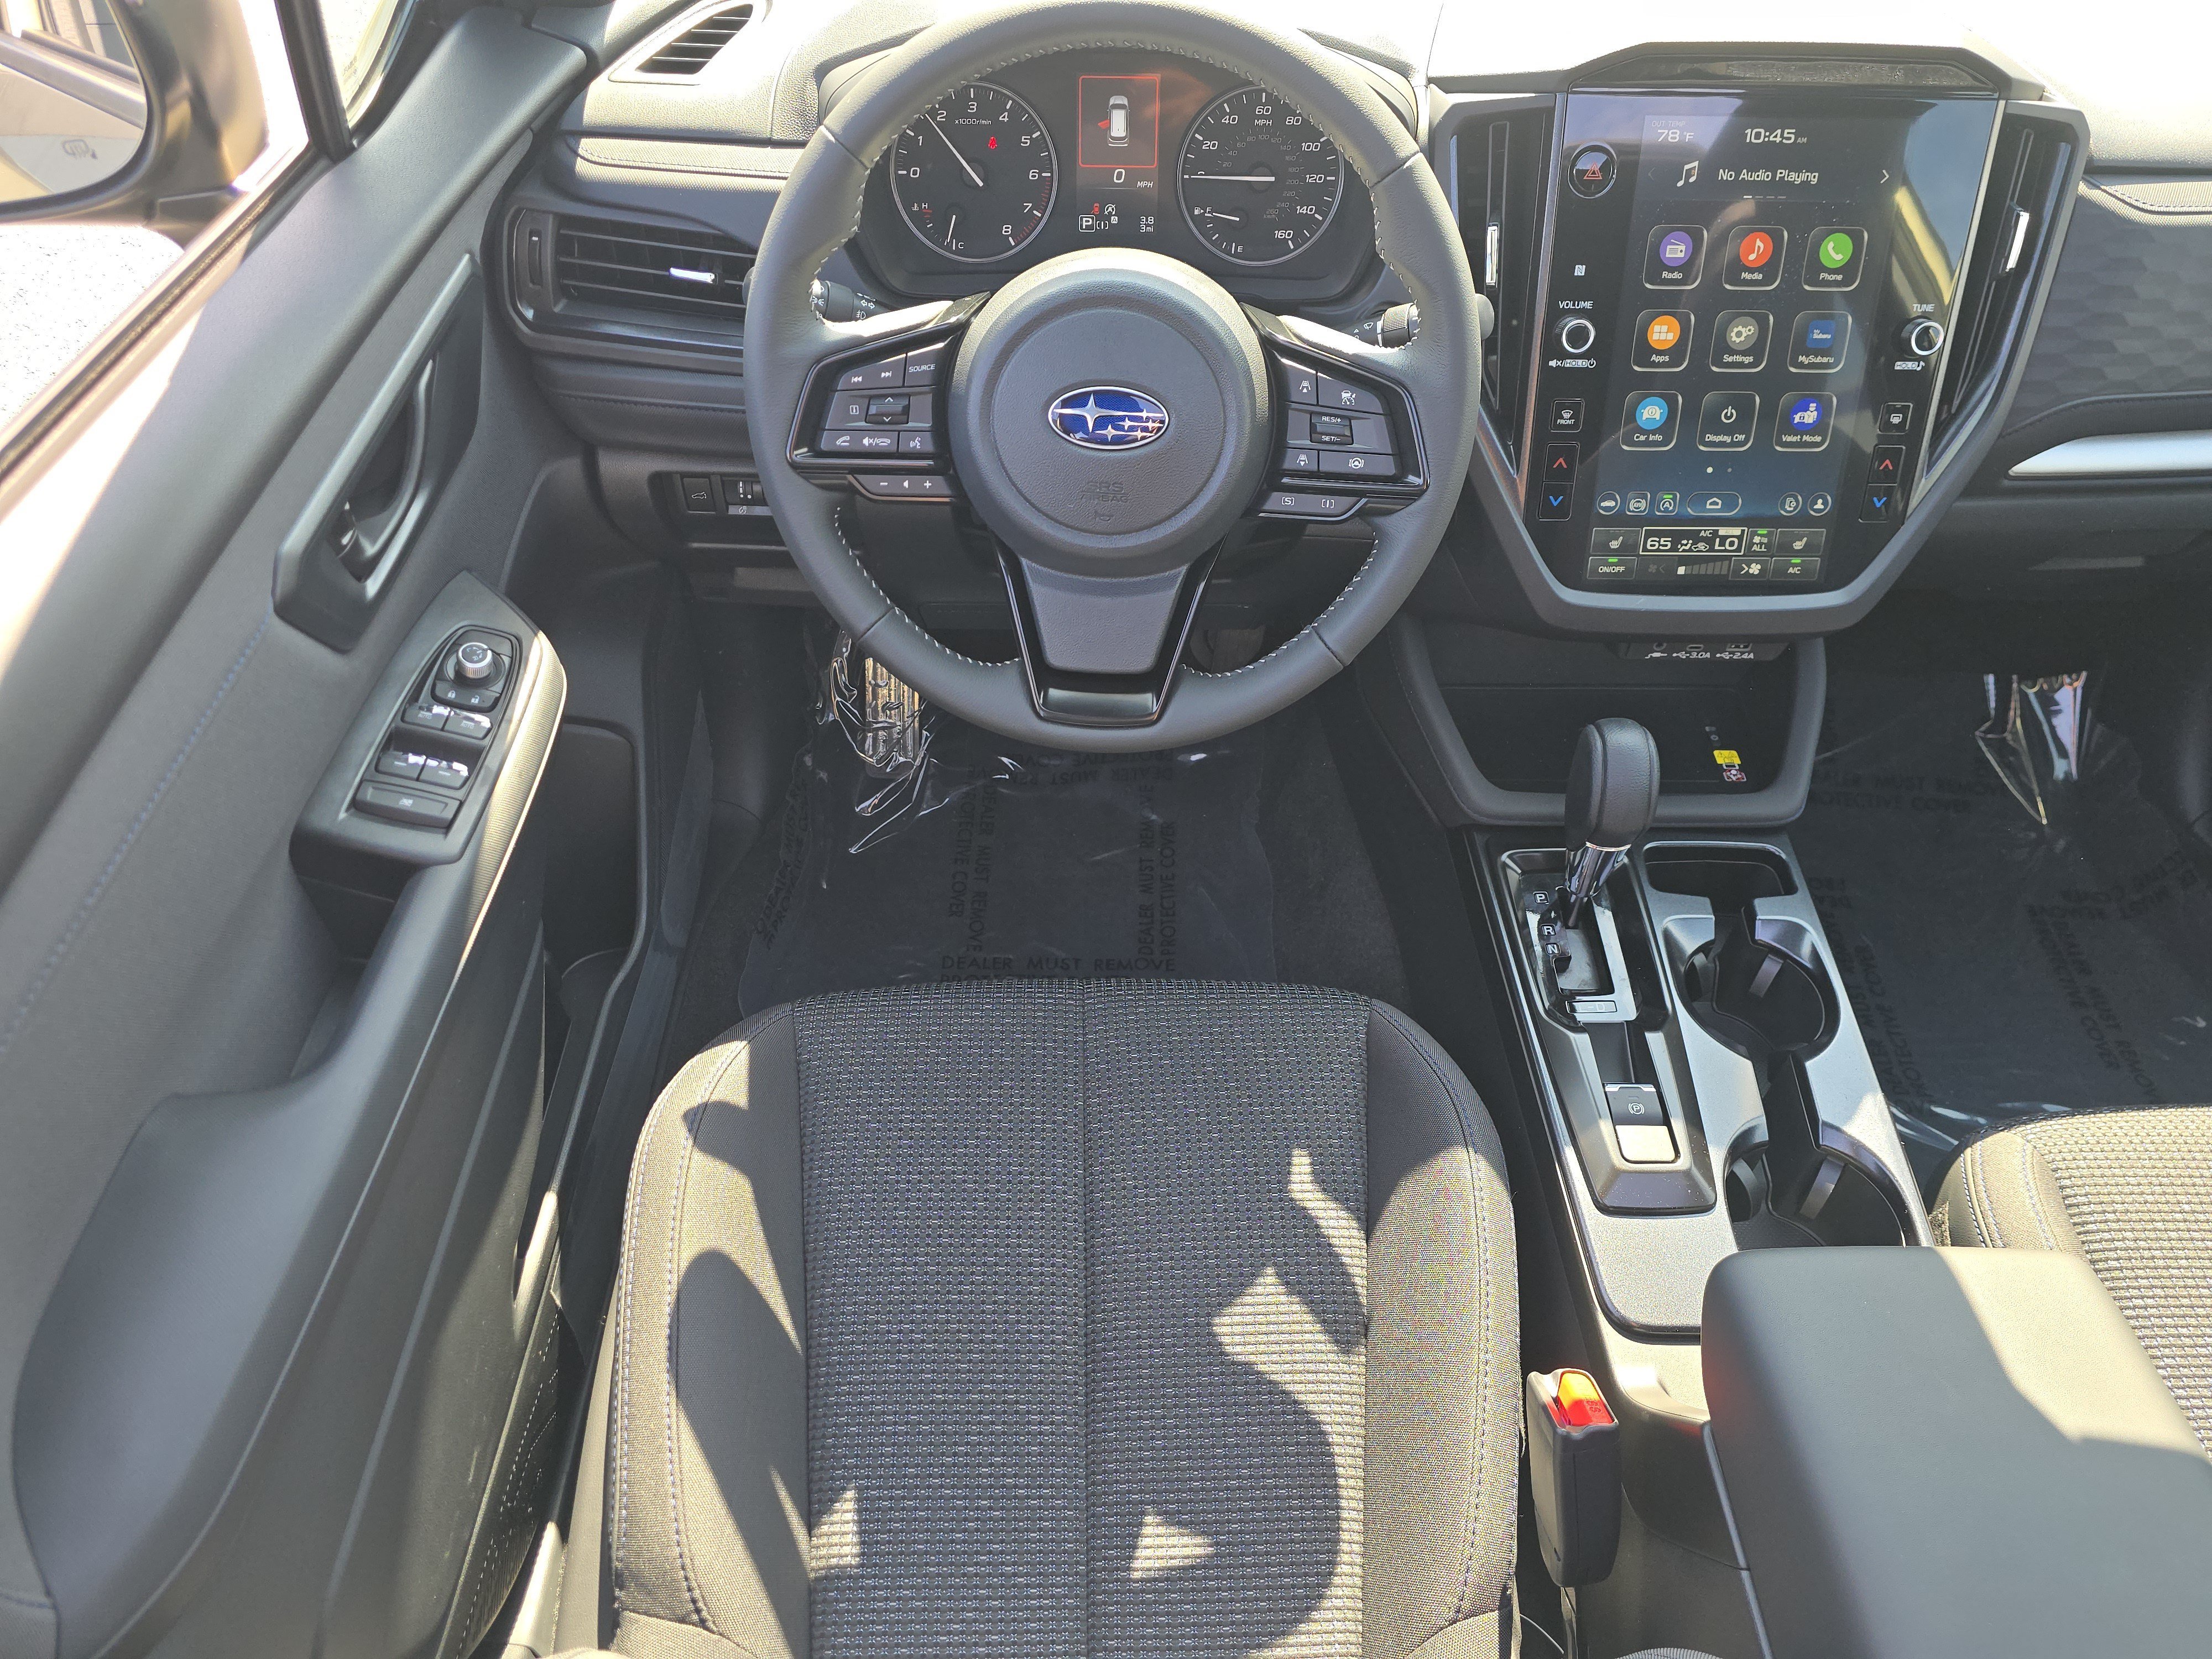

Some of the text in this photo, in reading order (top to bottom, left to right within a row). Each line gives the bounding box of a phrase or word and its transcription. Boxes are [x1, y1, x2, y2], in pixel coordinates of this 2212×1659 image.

[967, 102, 977, 113] 3
[1255, 106, 1272, 115] 60
[936, 111, 947, 121] 2
[999, 112, 1009, 122] 4
[1221, 115, 1238, 124] 40
[1285, 116, 1302, 126] 80
[1657, 129, 1680, 142] 78
[1744, 128, 1796, 144] 10:45
[917, 136, 924, 146] 1
[1020, 136, 1030, 147] 5
[1202, 140, 1218, 150] 20
[1301, 142, 1321, 152] 100
[910, 167, 920, 178] 0
[1029, 169, 1039, 180] 6
[1113, 168, 1125, 183] 0
[1718, 169, 1819, 185] No Audio Playing
[1305, 174, 1324, 183] 120
[1023, 203, 1032, 213] 7
[1295, 206, 1316, 215] 140
[1082, 217, 1092, 229] P
[1140, 216, 1154, 225] 3.8
[1002, 225, 1012, 235] 8
[1140, 224, 1154, 233] 3mi
[1274, 229, 1294, 239] 160
[1661, 271, 1683, 279] Radio
[1741, 272, 1763, 280] Media
[1819, 272, 1843, 281] Phone
[1558, 300, 1594, 309] VOLUME
[1912, 303, 1936, 312] TUNE
[1650, 354, 1670, 363] Apps
[1723, 354, 1754, 363] Settings
[1798, 355, 1834, 364] MySubaru
[909, 363, 936, 373] SOURCE
[1634, 433, 1663, 442] Car Info
[1705, 434, 1746, 442] Display Off
[1802, 434, 1822, 442] Mode
[1646, 538, 1672, 550] 65
[1714, 538, 1739, 550] LO
[1751, 544, 1767, 552] ALL
[1787, 566, 1802, 575] A/C
[1689, 651, 1710, 660] 3.0A
[1536, 894, 1546, 902] P
[1545, 925, 1554, 935] R
[1548, 944, 1558, 953] N
[941, 955, 1176, 972] DEALER MUST REMOVE
